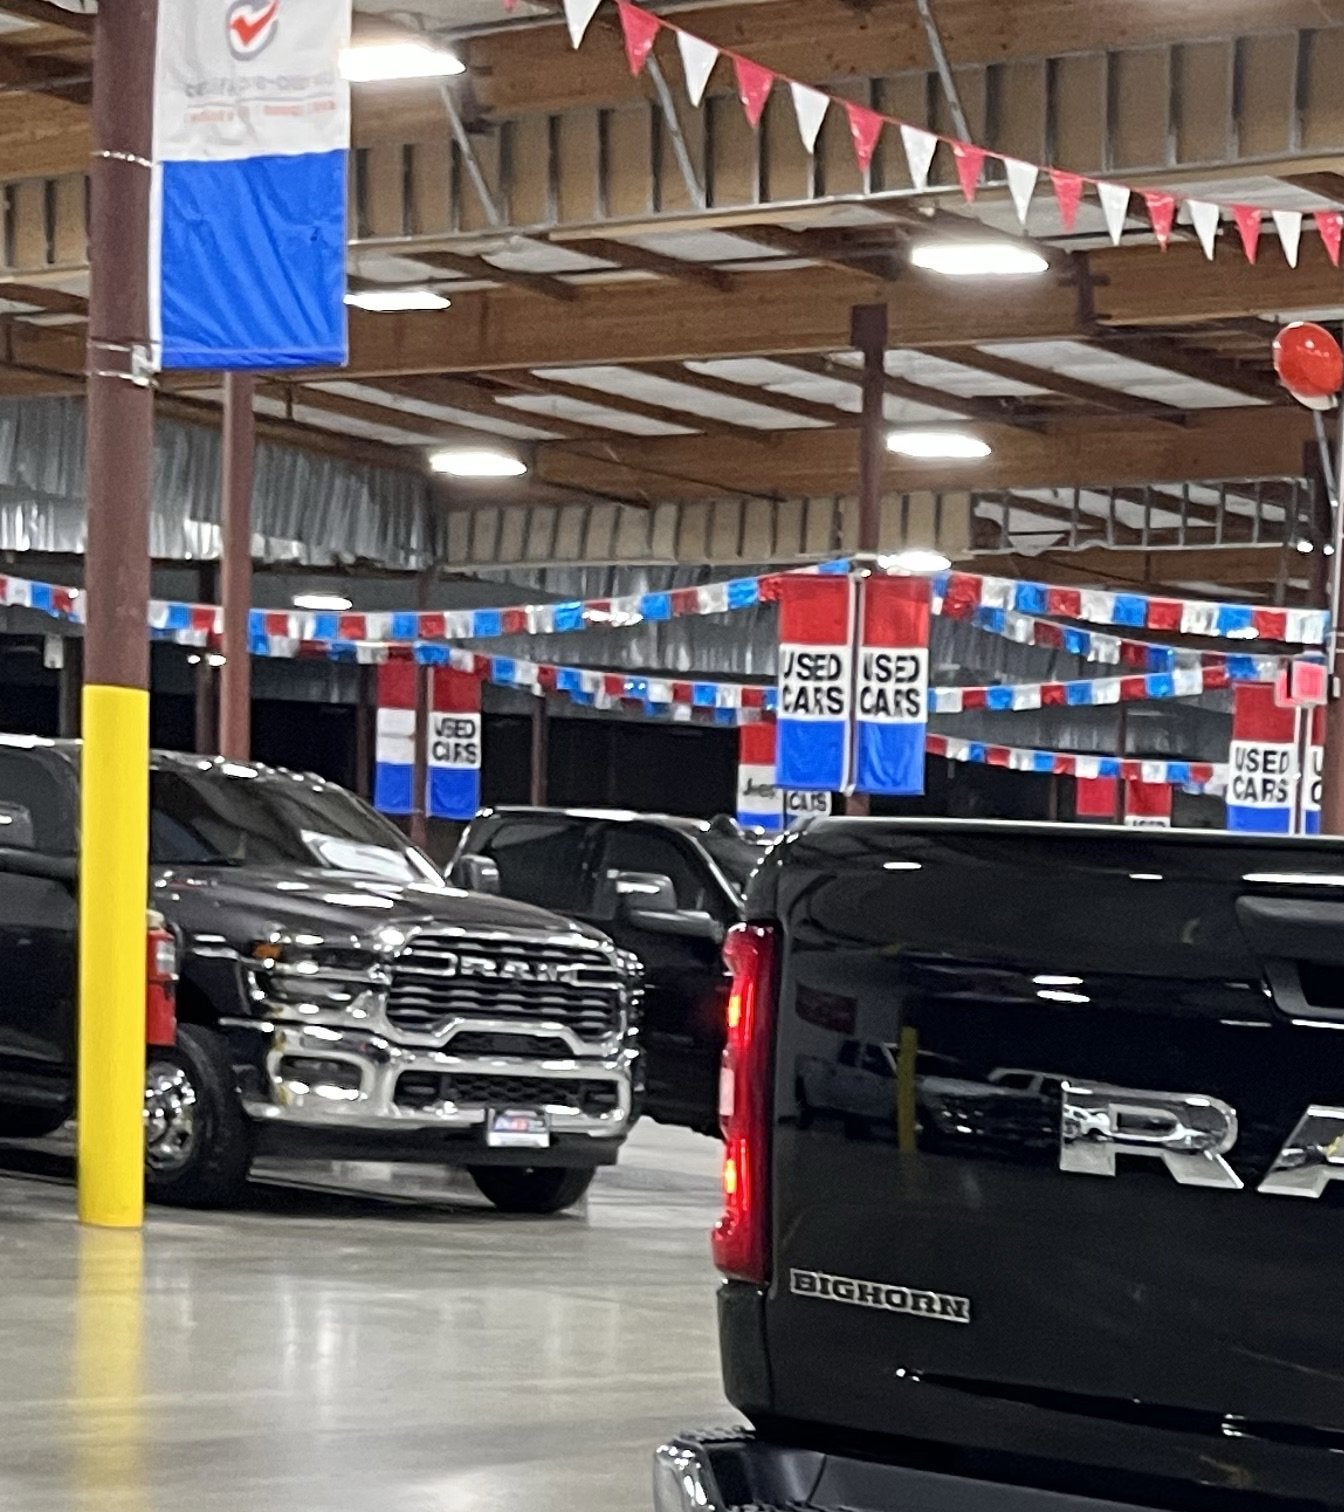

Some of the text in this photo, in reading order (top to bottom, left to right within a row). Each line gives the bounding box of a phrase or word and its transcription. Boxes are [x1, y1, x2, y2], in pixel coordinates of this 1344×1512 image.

[1235, 747, 1290, 774] USED
[1232, 775, 1289, 803] CARS
[791, 1268, 969, 1322] BIGHORN
